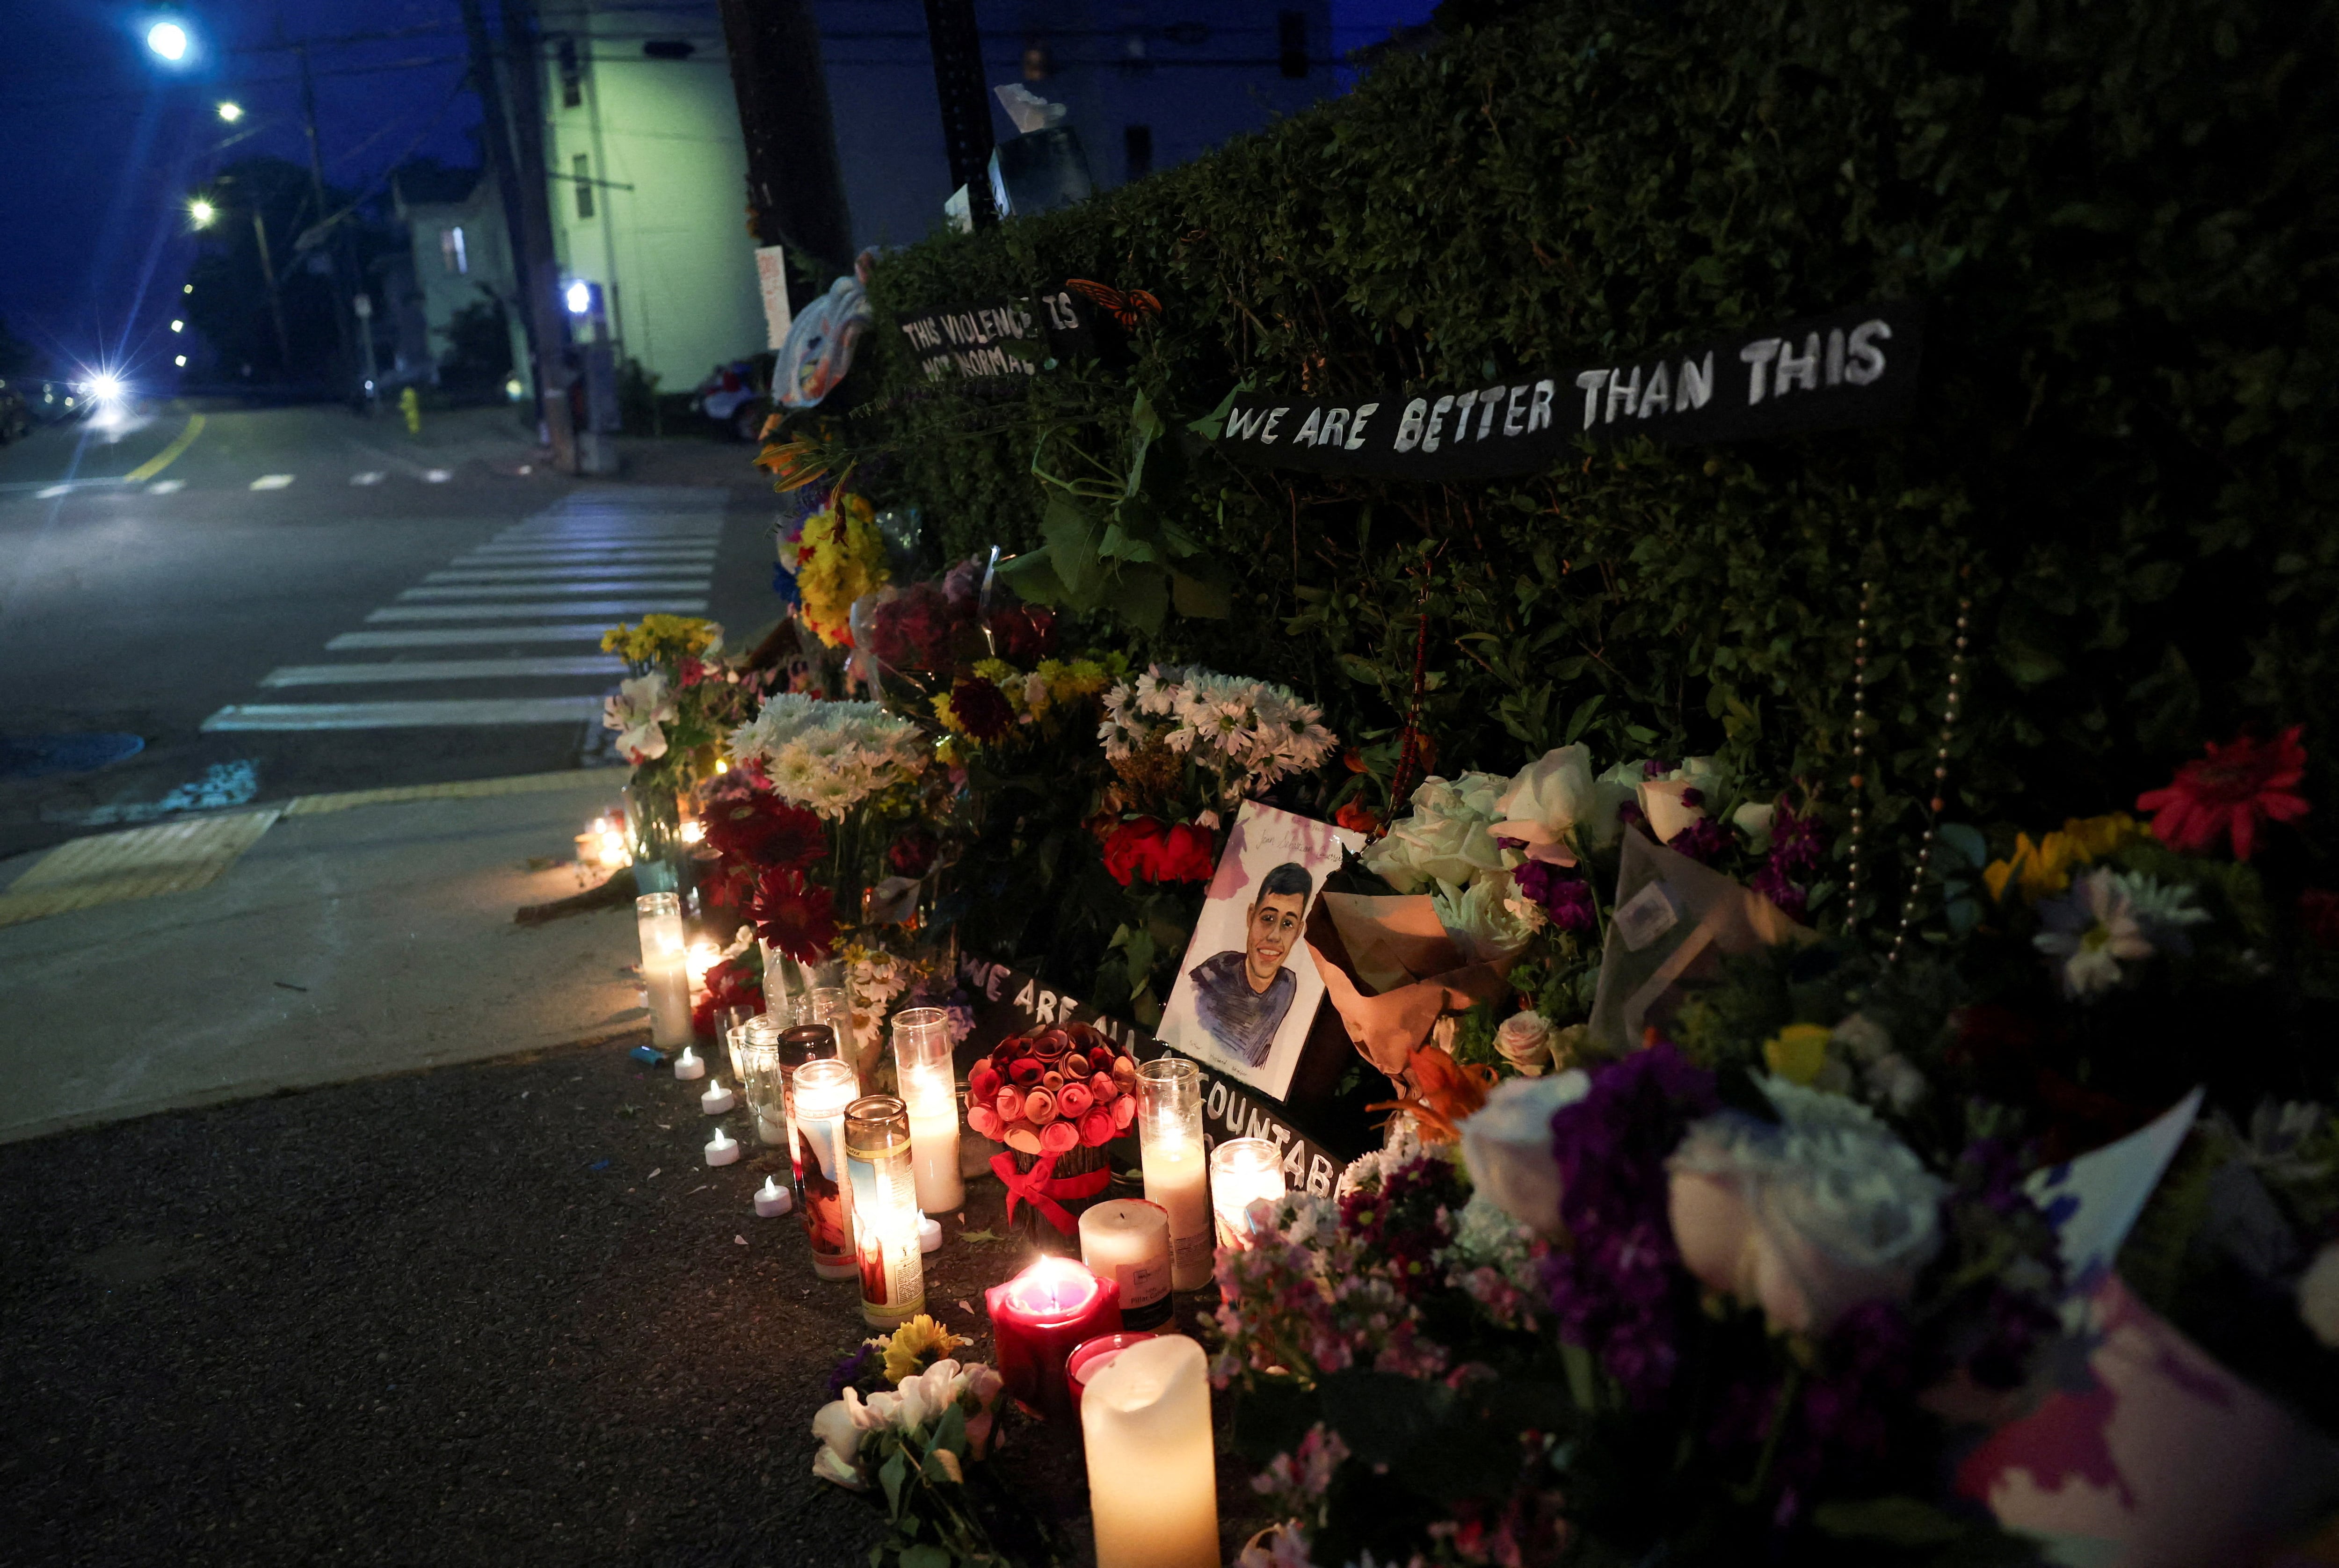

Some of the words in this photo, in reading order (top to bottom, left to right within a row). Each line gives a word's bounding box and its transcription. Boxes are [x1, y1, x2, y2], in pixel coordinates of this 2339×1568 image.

[902, 317, 942, 351] THIS
[1042, 292, 1078, 329] IS
[1226, 407, 1290, 444] WE
[1293, 403, 1380, 450] ARE
[1394, 379, 1555, 453] BETTER
[1576, 350, 1714, 430] THAN
[1740, 319, 1892, 406] THIS
[961, 951, 1011, 1002] WE
[1013, 978, 1079, 1025] ARE
